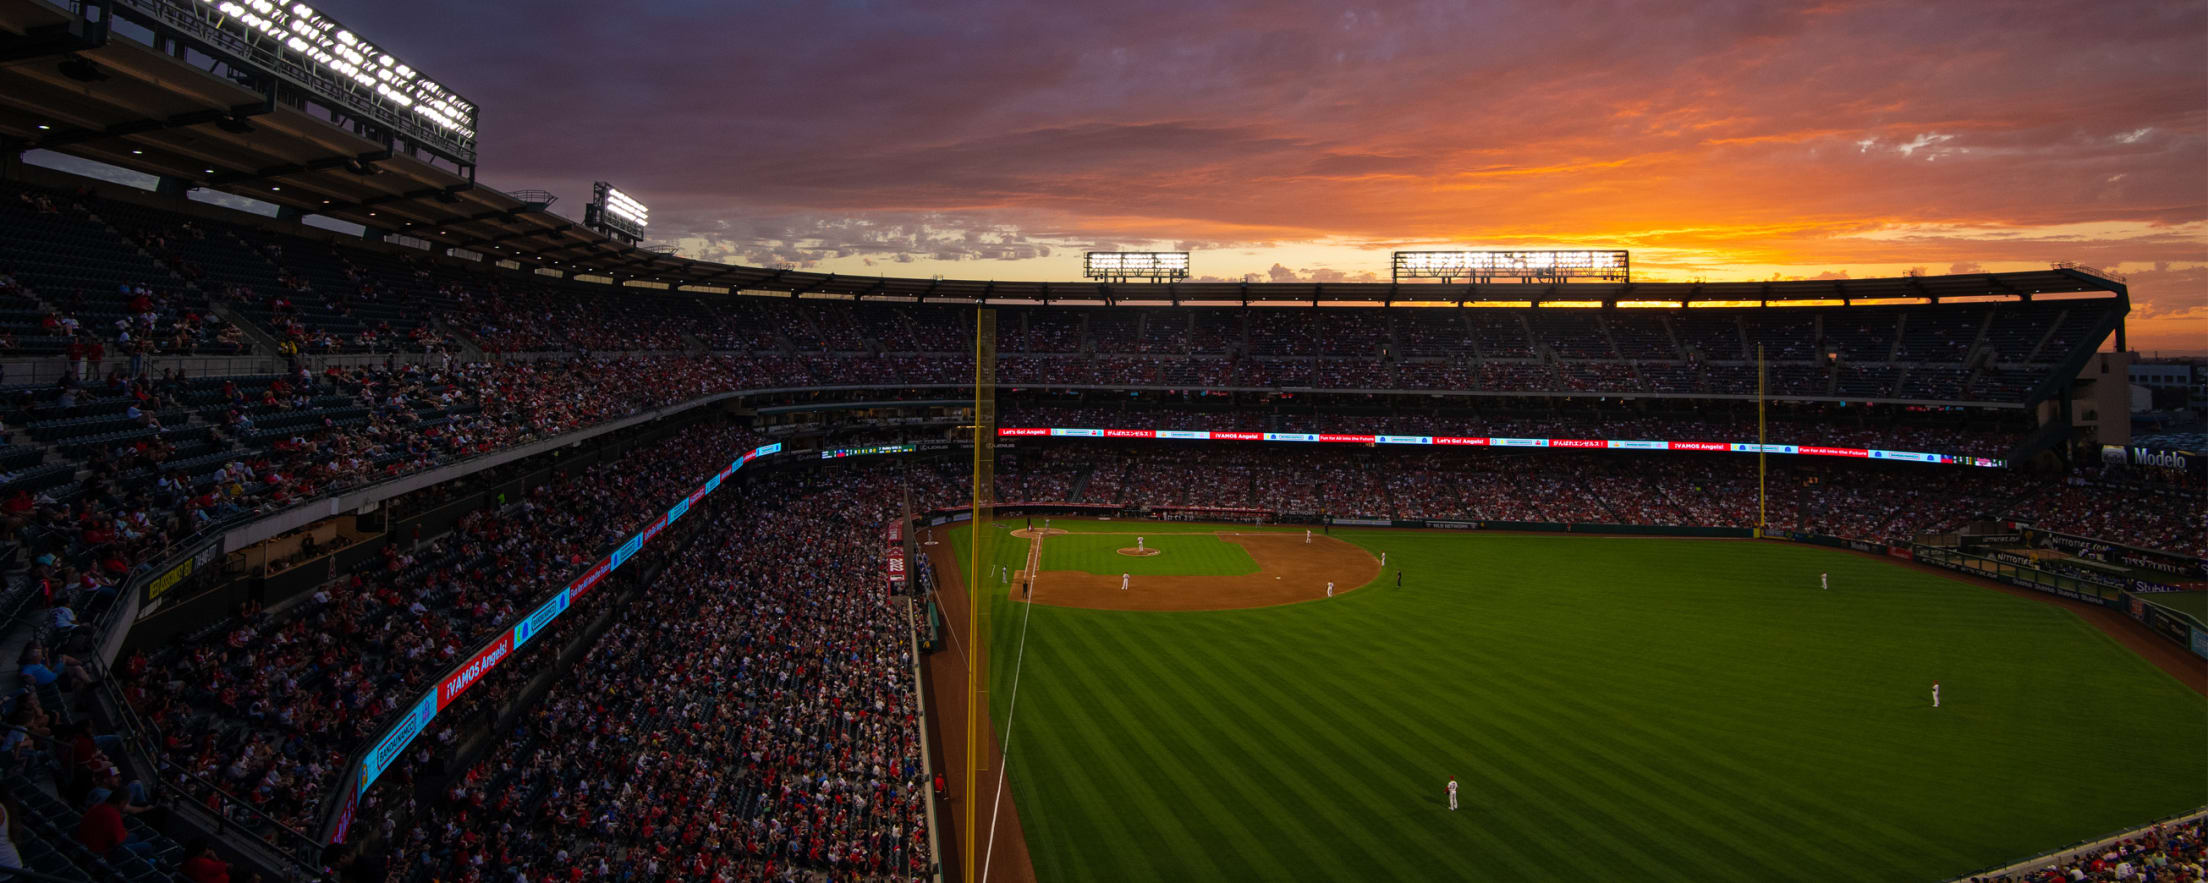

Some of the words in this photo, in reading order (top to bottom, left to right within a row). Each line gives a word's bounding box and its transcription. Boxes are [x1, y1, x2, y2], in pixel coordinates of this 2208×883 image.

[2134, 447, 2186, 468] Modelo
[445, 665, 480, 700] ¡VAMOS
[480, 640, 508, 673] Angels!
